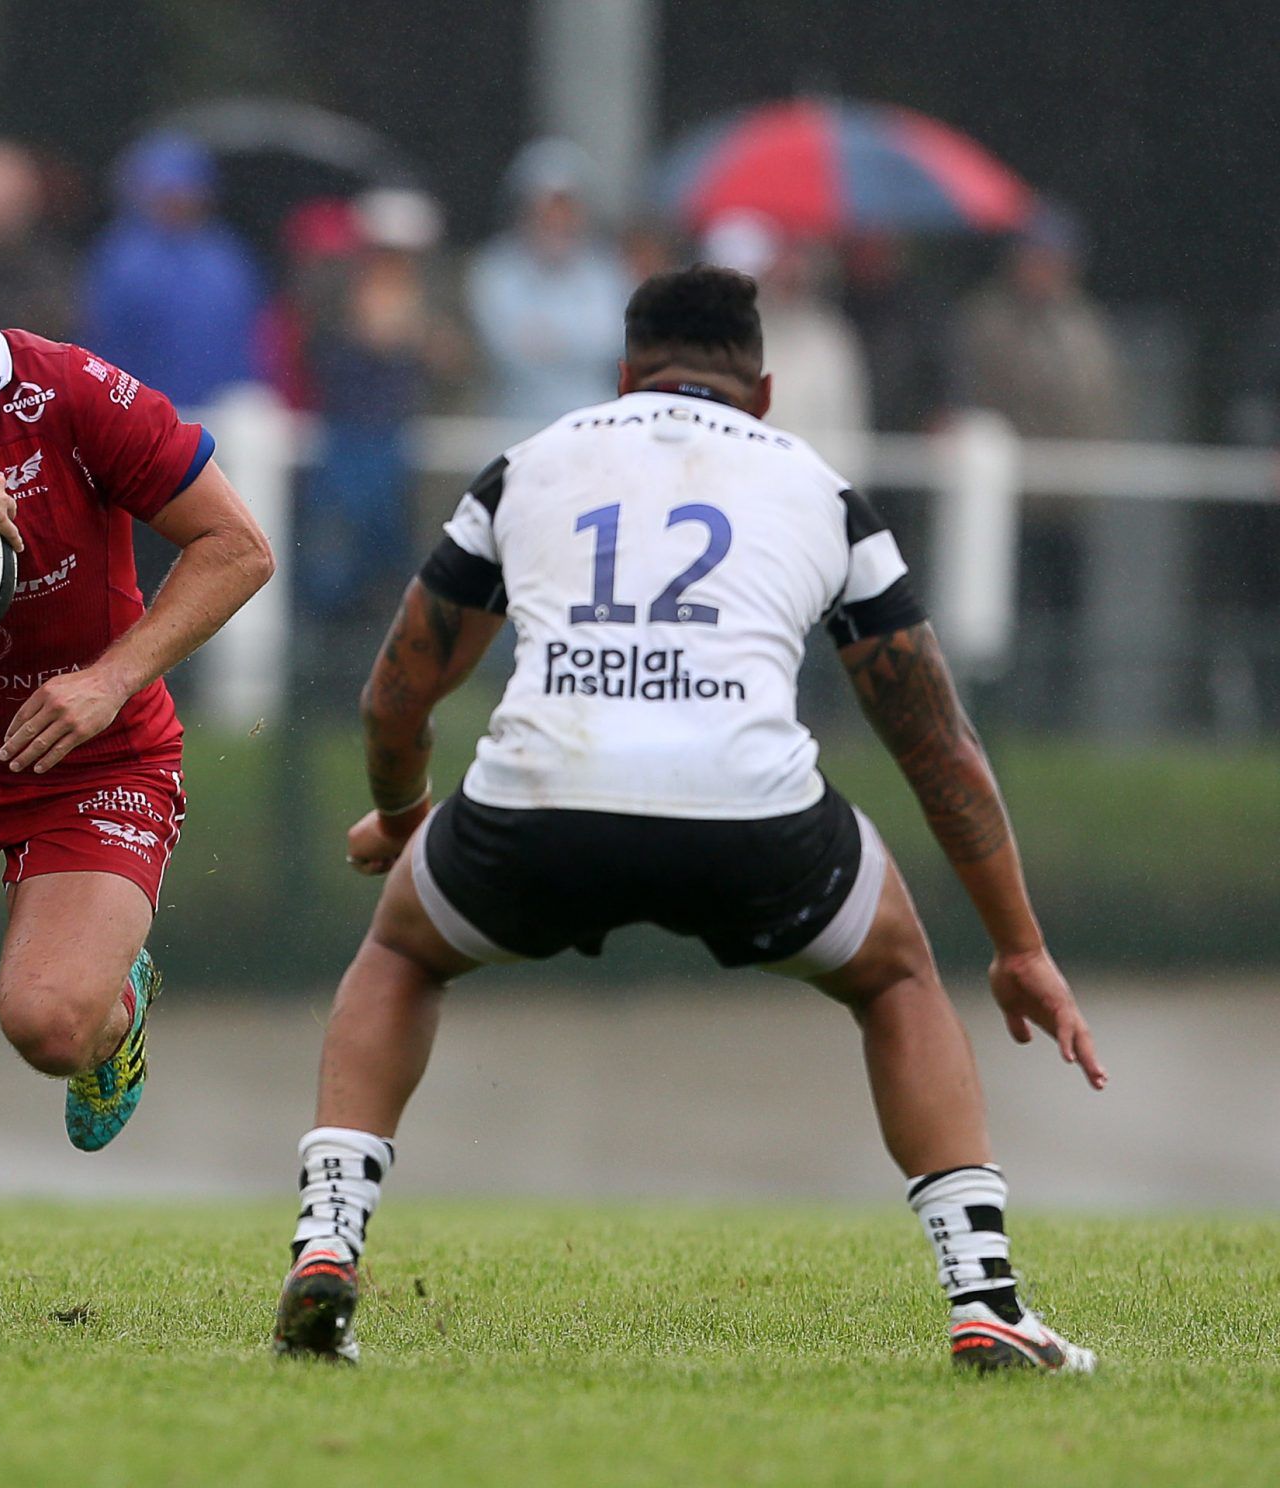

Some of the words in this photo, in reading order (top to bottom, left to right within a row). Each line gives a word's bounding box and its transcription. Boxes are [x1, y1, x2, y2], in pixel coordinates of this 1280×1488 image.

[3, 388, 56, 413] owens
[570, 502, 732, 625] 12
[547, 642, 684, 676] Poplar
[544, 669, 746, 702] Insulation
